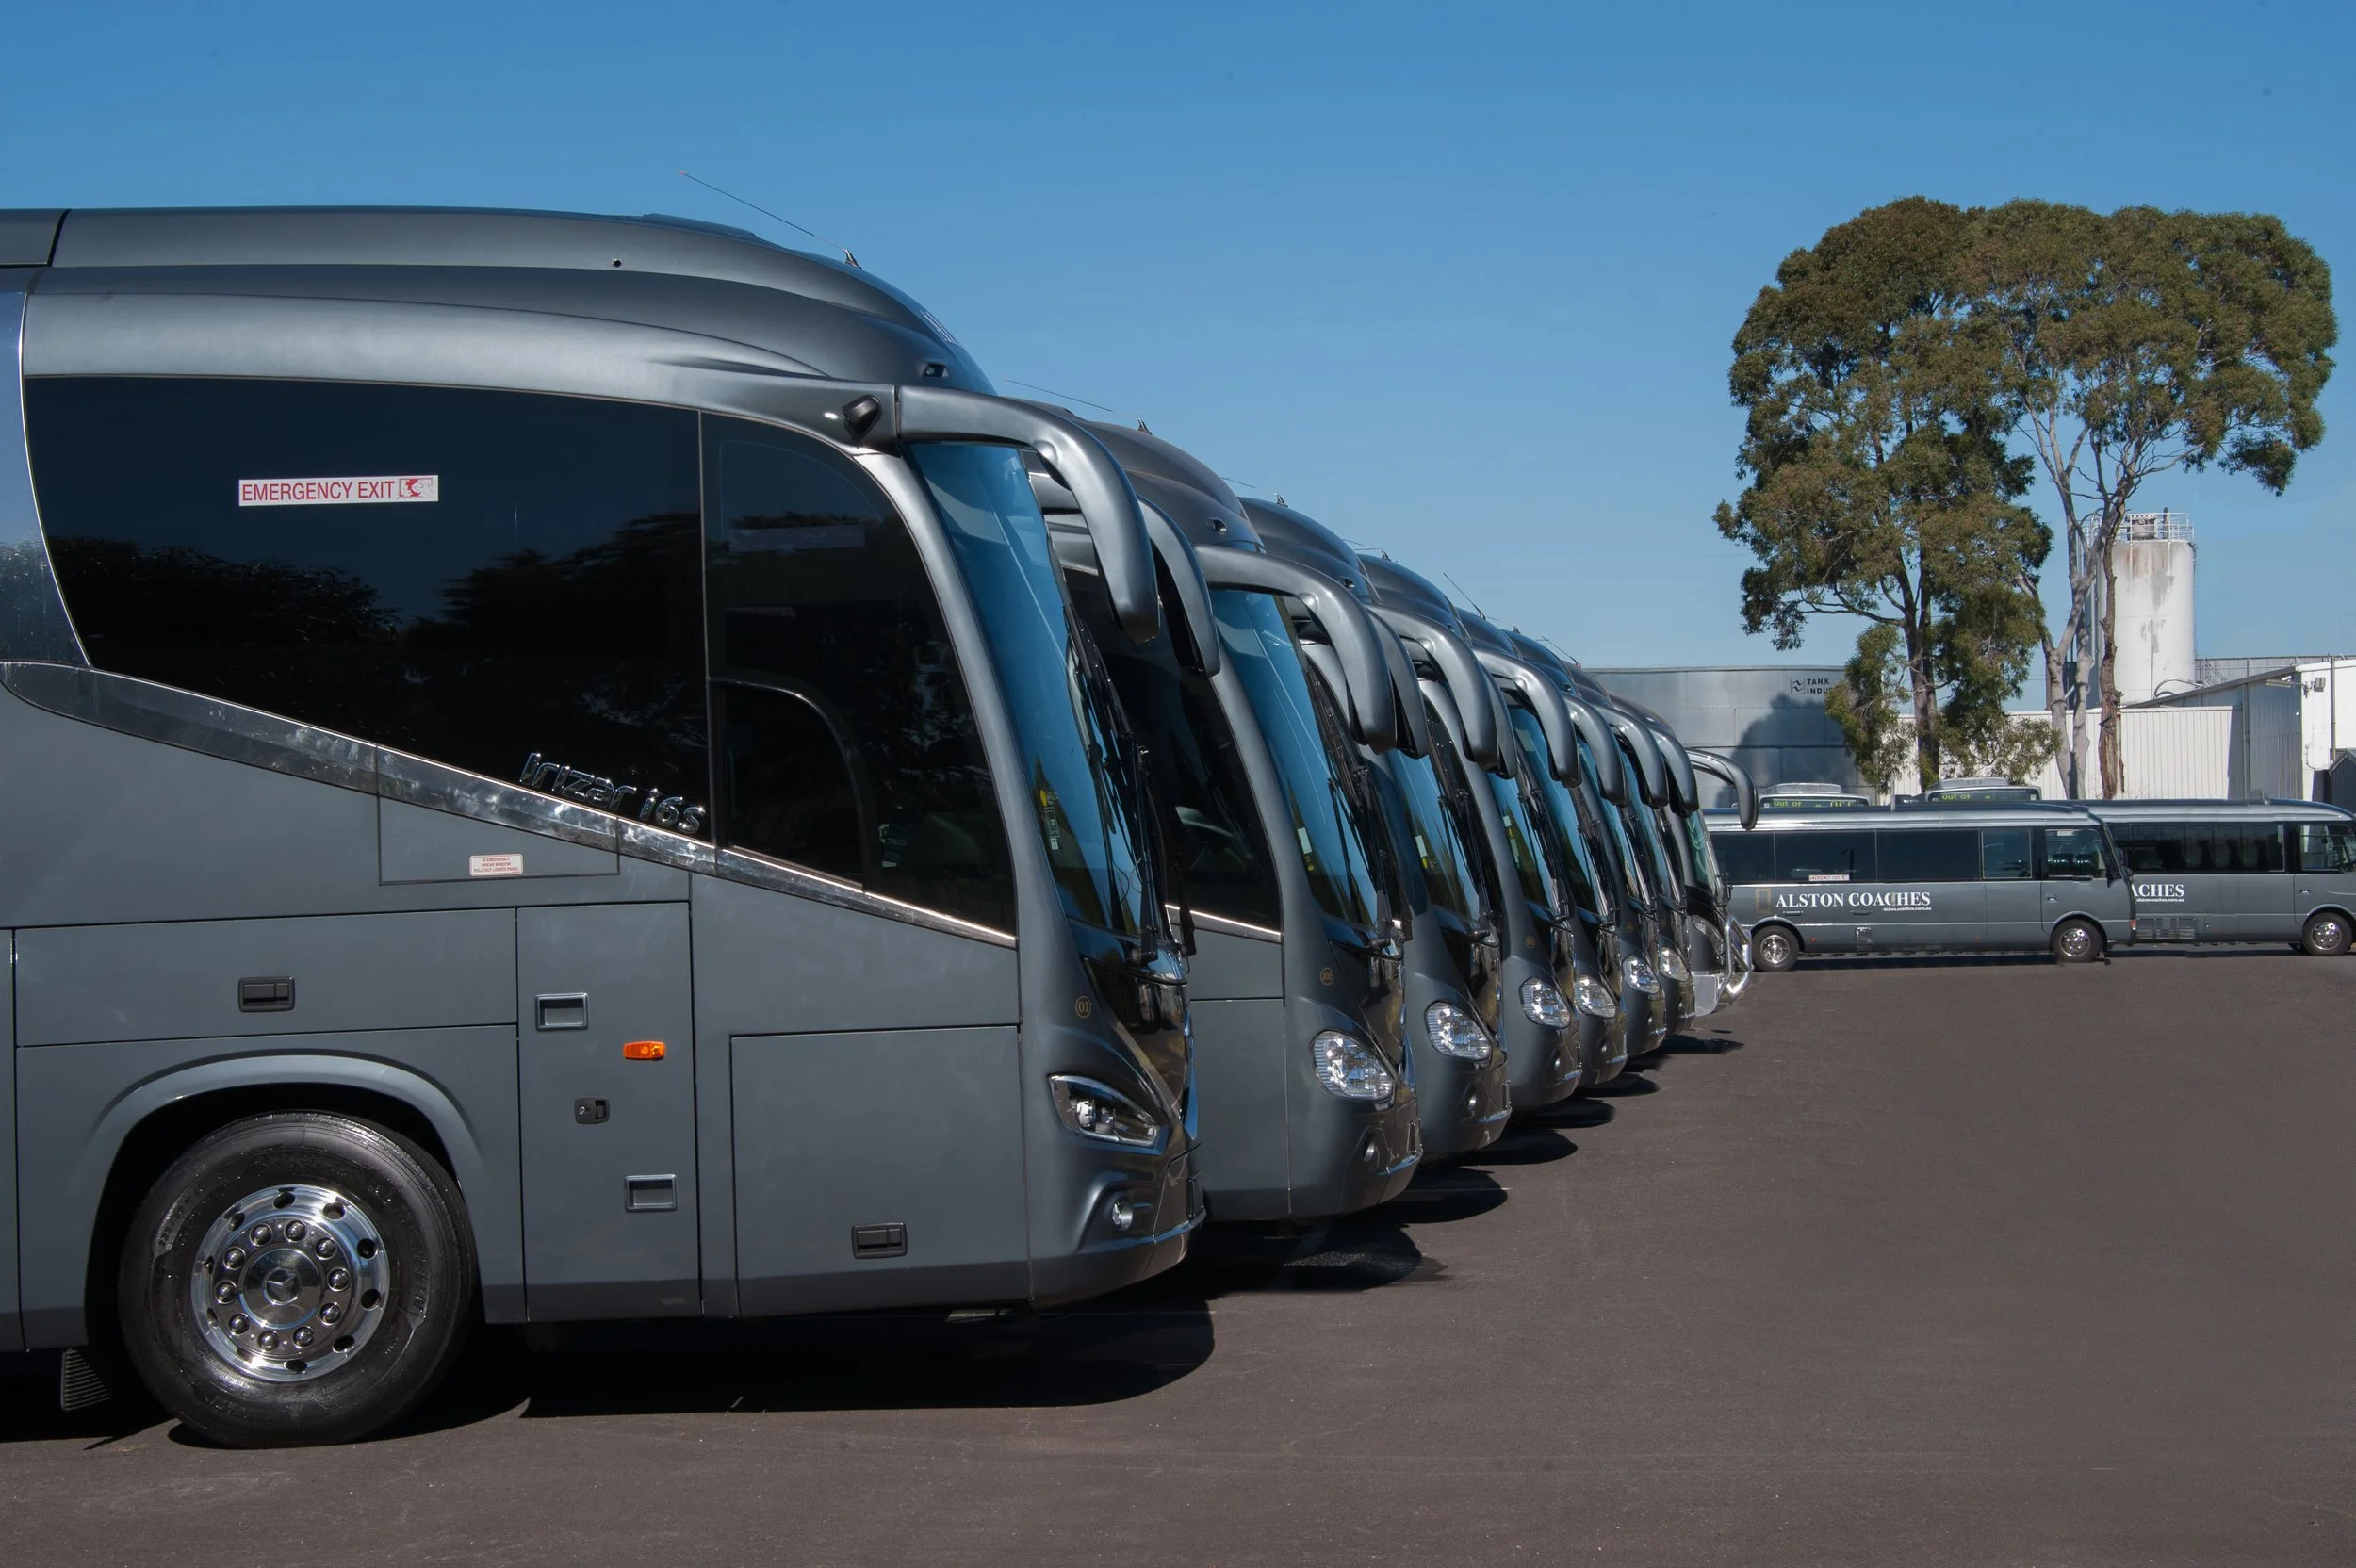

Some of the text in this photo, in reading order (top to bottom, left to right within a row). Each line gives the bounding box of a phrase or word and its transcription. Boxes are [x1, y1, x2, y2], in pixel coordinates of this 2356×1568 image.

[242, 481, 395, 501] EMERGENCY EXIT
[1775, 891, 1931, 907] ALSTON COACHES
